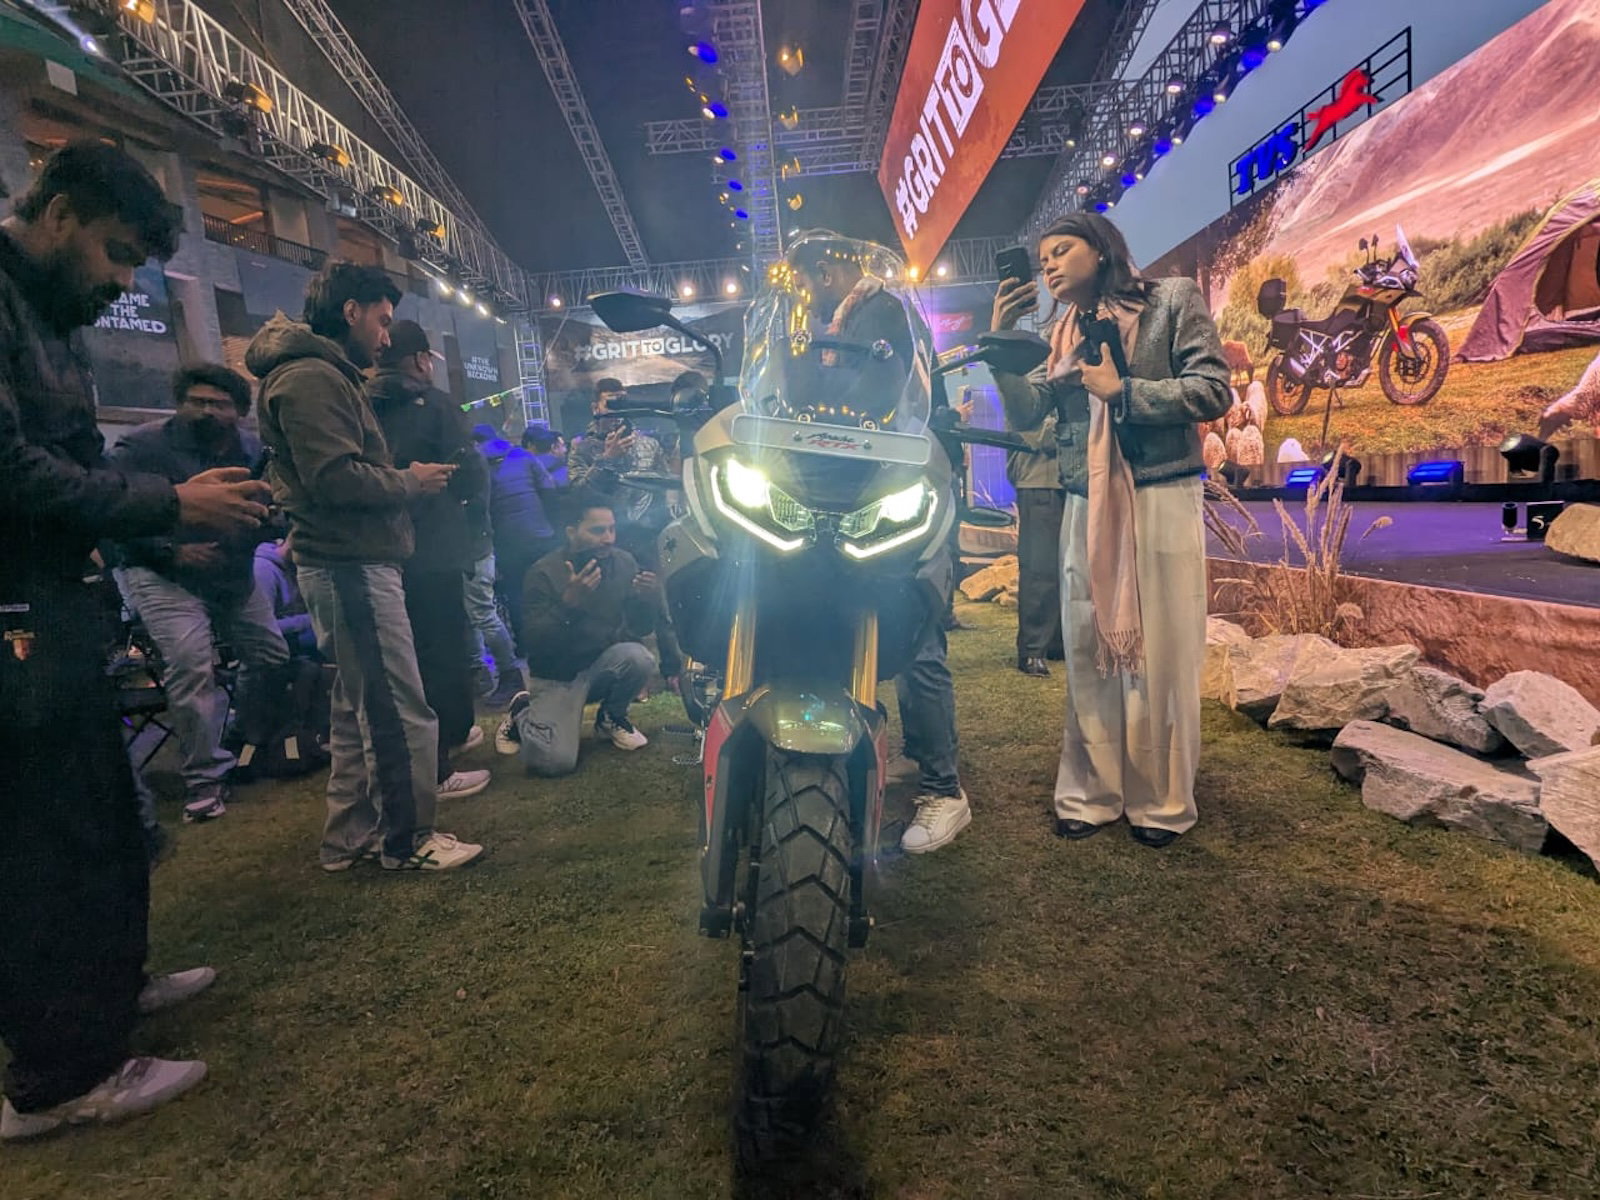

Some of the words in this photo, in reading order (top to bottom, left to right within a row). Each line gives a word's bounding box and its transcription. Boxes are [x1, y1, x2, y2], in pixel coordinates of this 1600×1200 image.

[896, 82, 955, 240] #GRIT
[961, 0, 1021, 68] G
[1236, 122, 1299, 195] TVS
[110, 303, 139, 318] THE
[114, 292, 150, 307] AME
[574, 339, 641, 361] #GRIT
